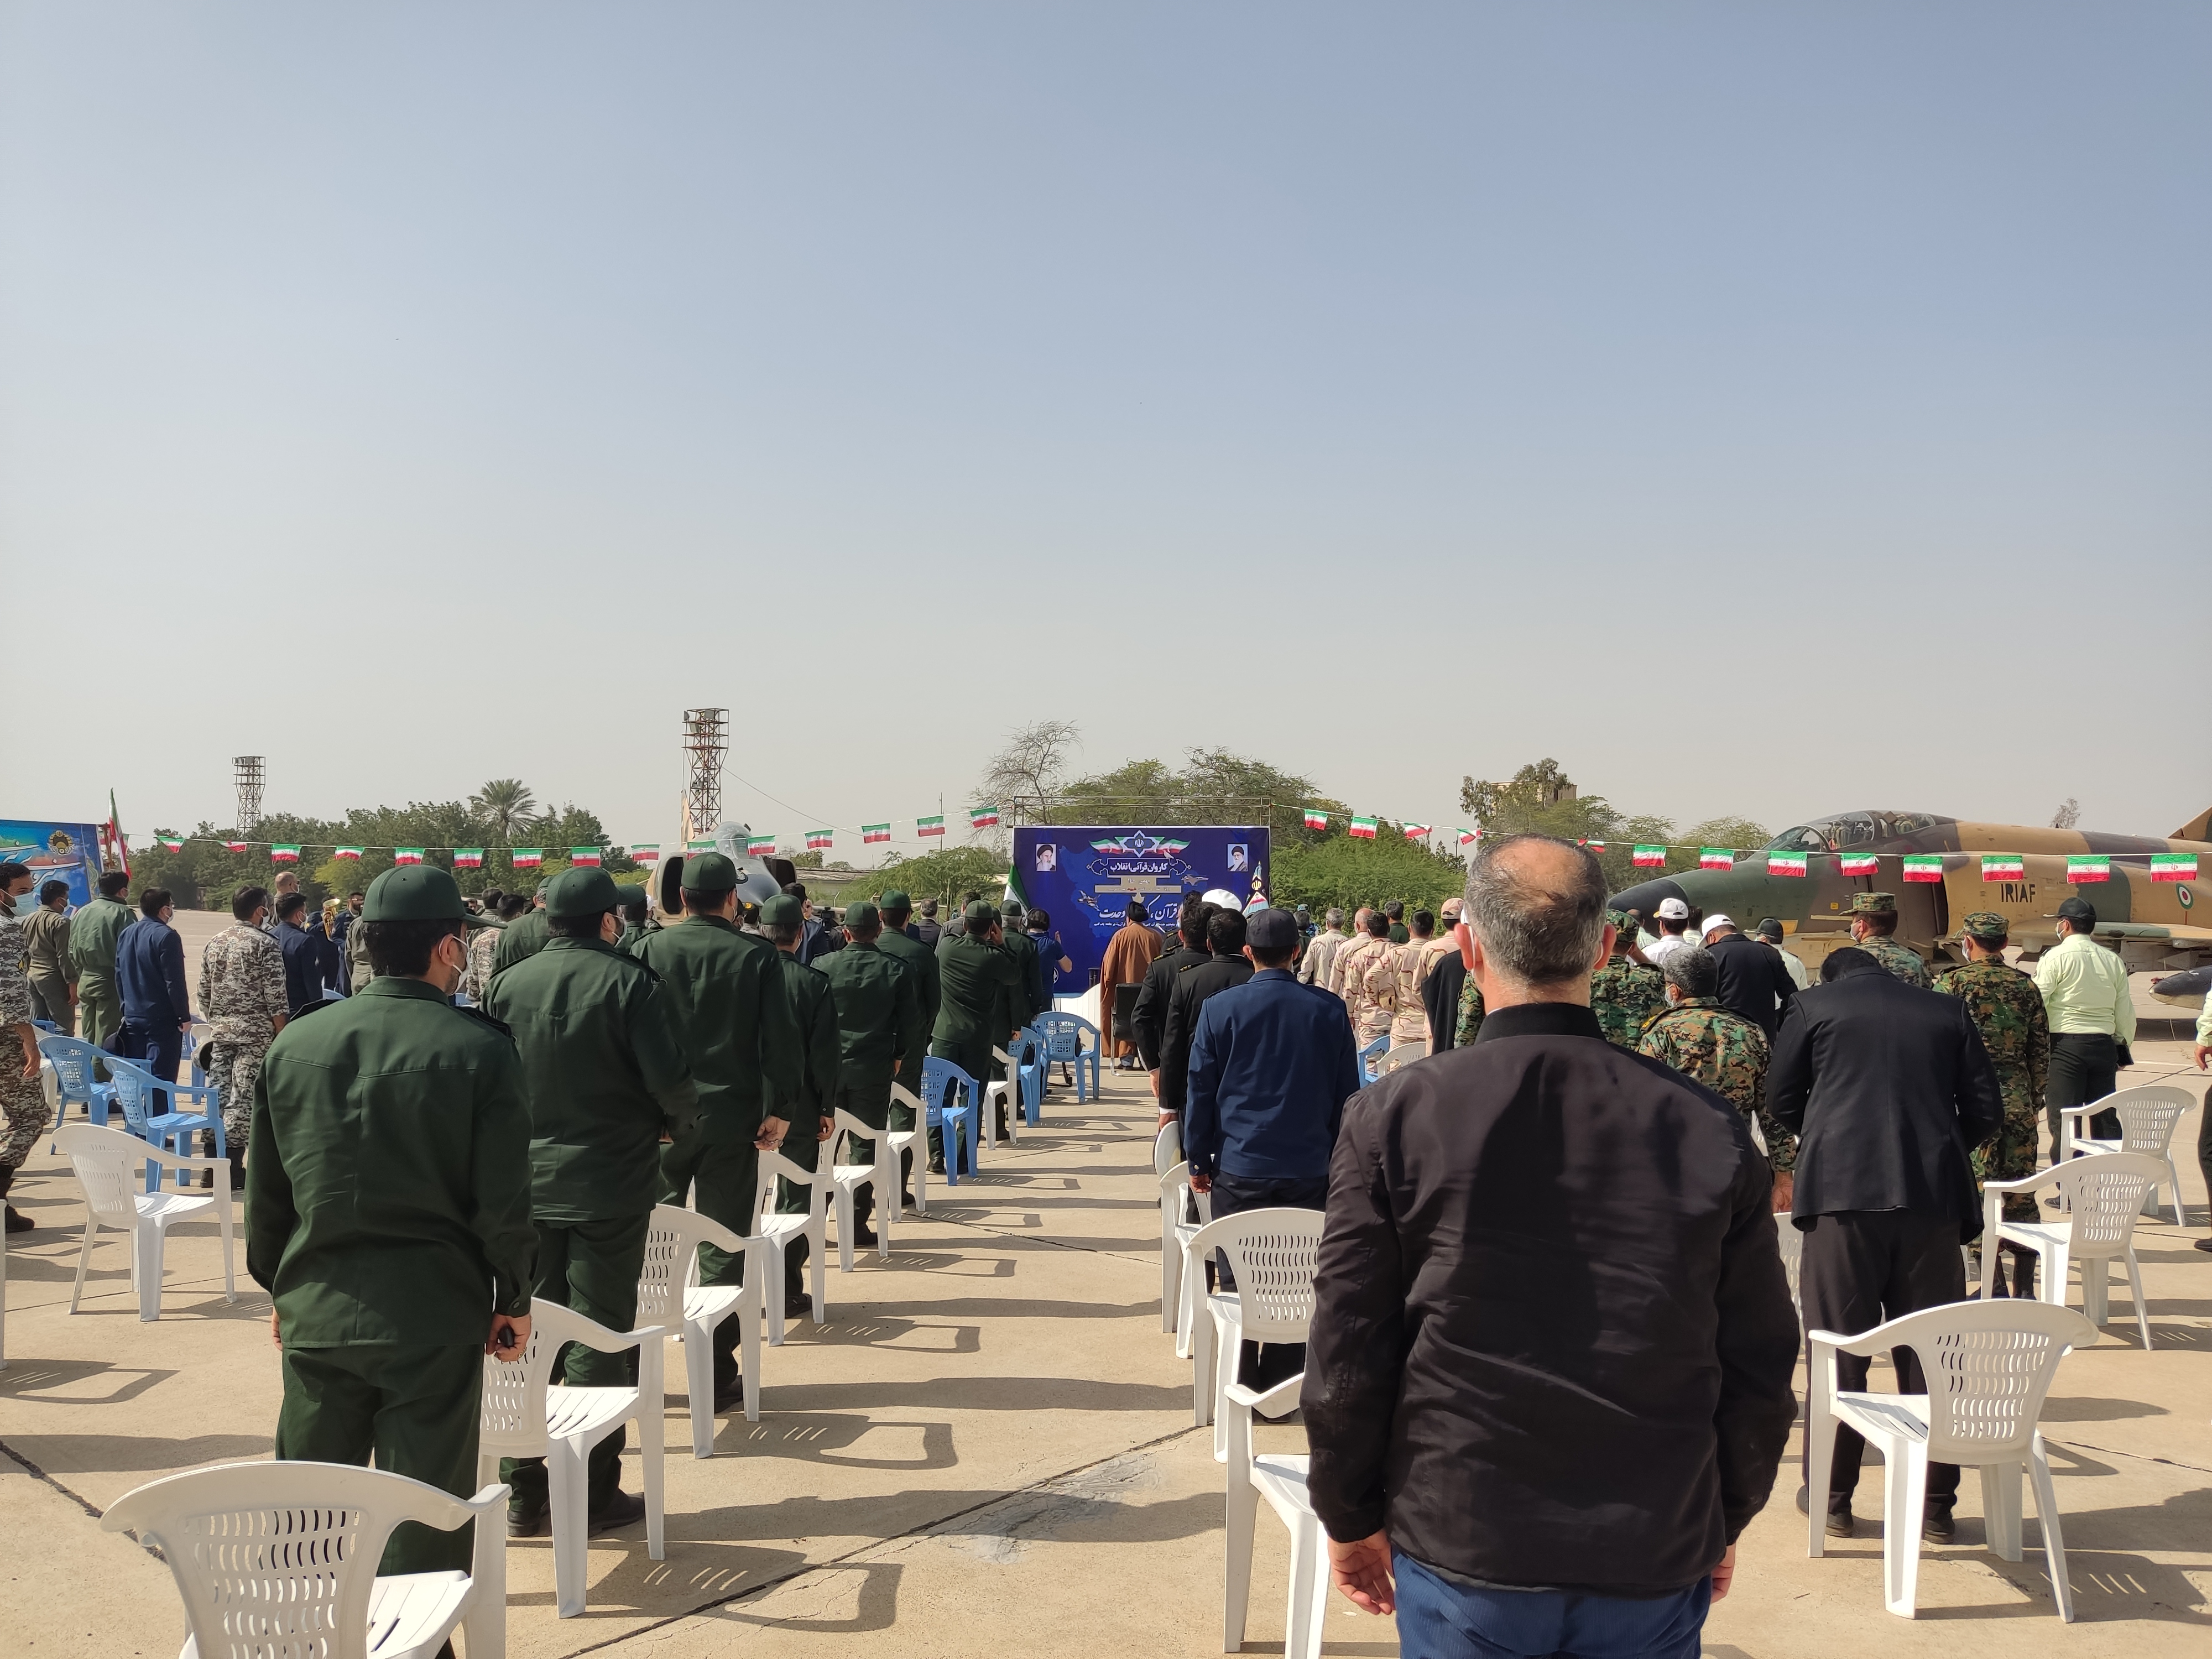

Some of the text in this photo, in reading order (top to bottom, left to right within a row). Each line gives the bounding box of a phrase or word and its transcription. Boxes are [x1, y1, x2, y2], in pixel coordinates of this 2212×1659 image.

[1110, 862, 1168, 873] کاروان قرآنی انقلاب
[2001, 883, 2036, 902] IRIAF
